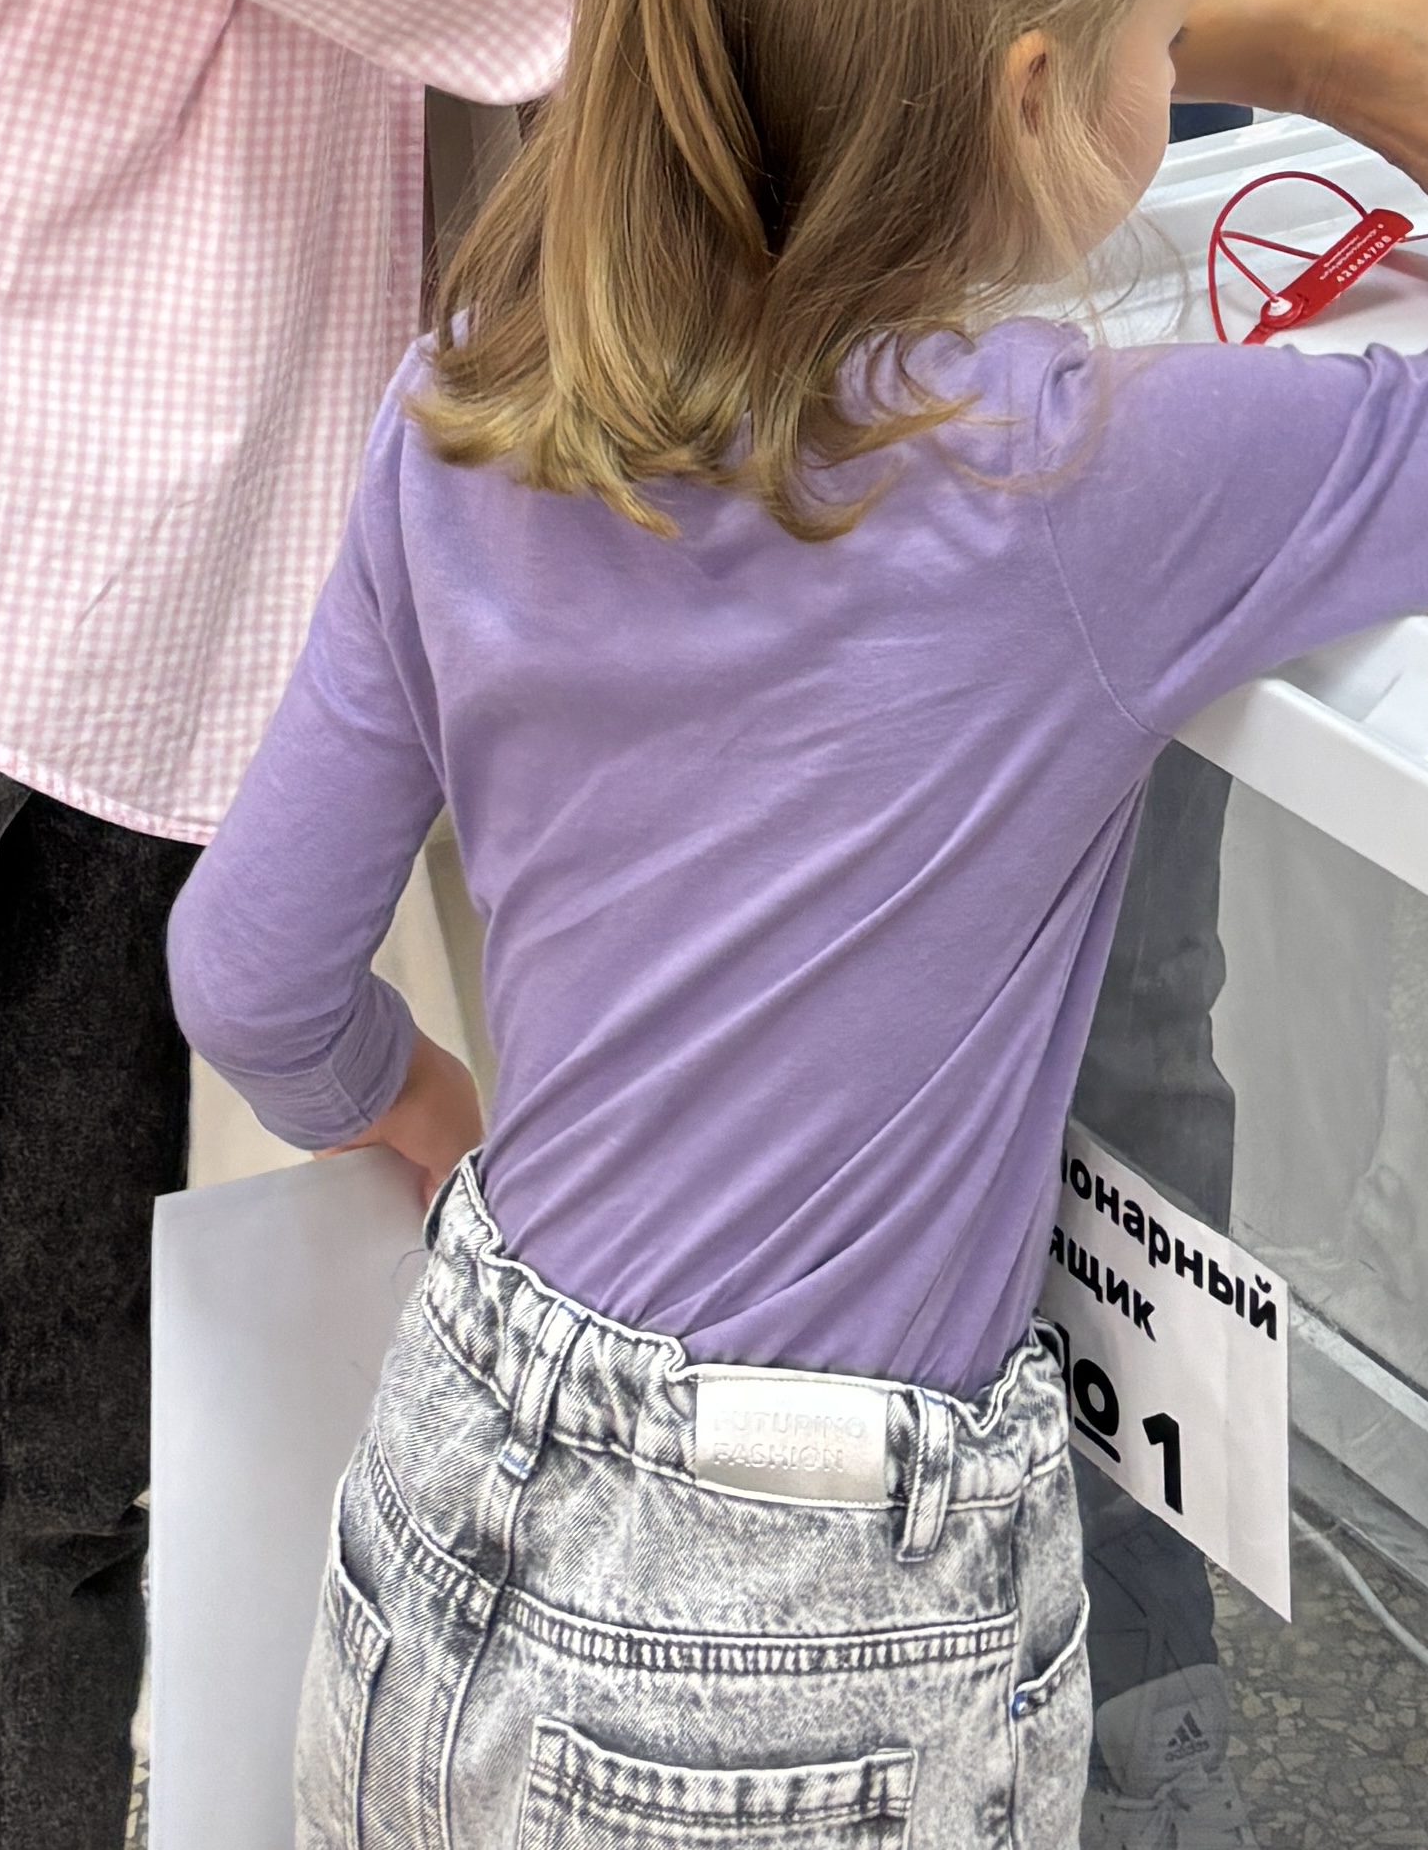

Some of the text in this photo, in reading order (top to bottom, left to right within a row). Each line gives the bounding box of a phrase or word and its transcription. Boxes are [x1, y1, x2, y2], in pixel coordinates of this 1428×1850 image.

[1049, 1224, 1158, 1344] ящик
[1061, 1152, 1278, 1342] онарный
[713, 1442, 845, 1474] FASHION
[1141, 1411, 1184, 1517] 1
